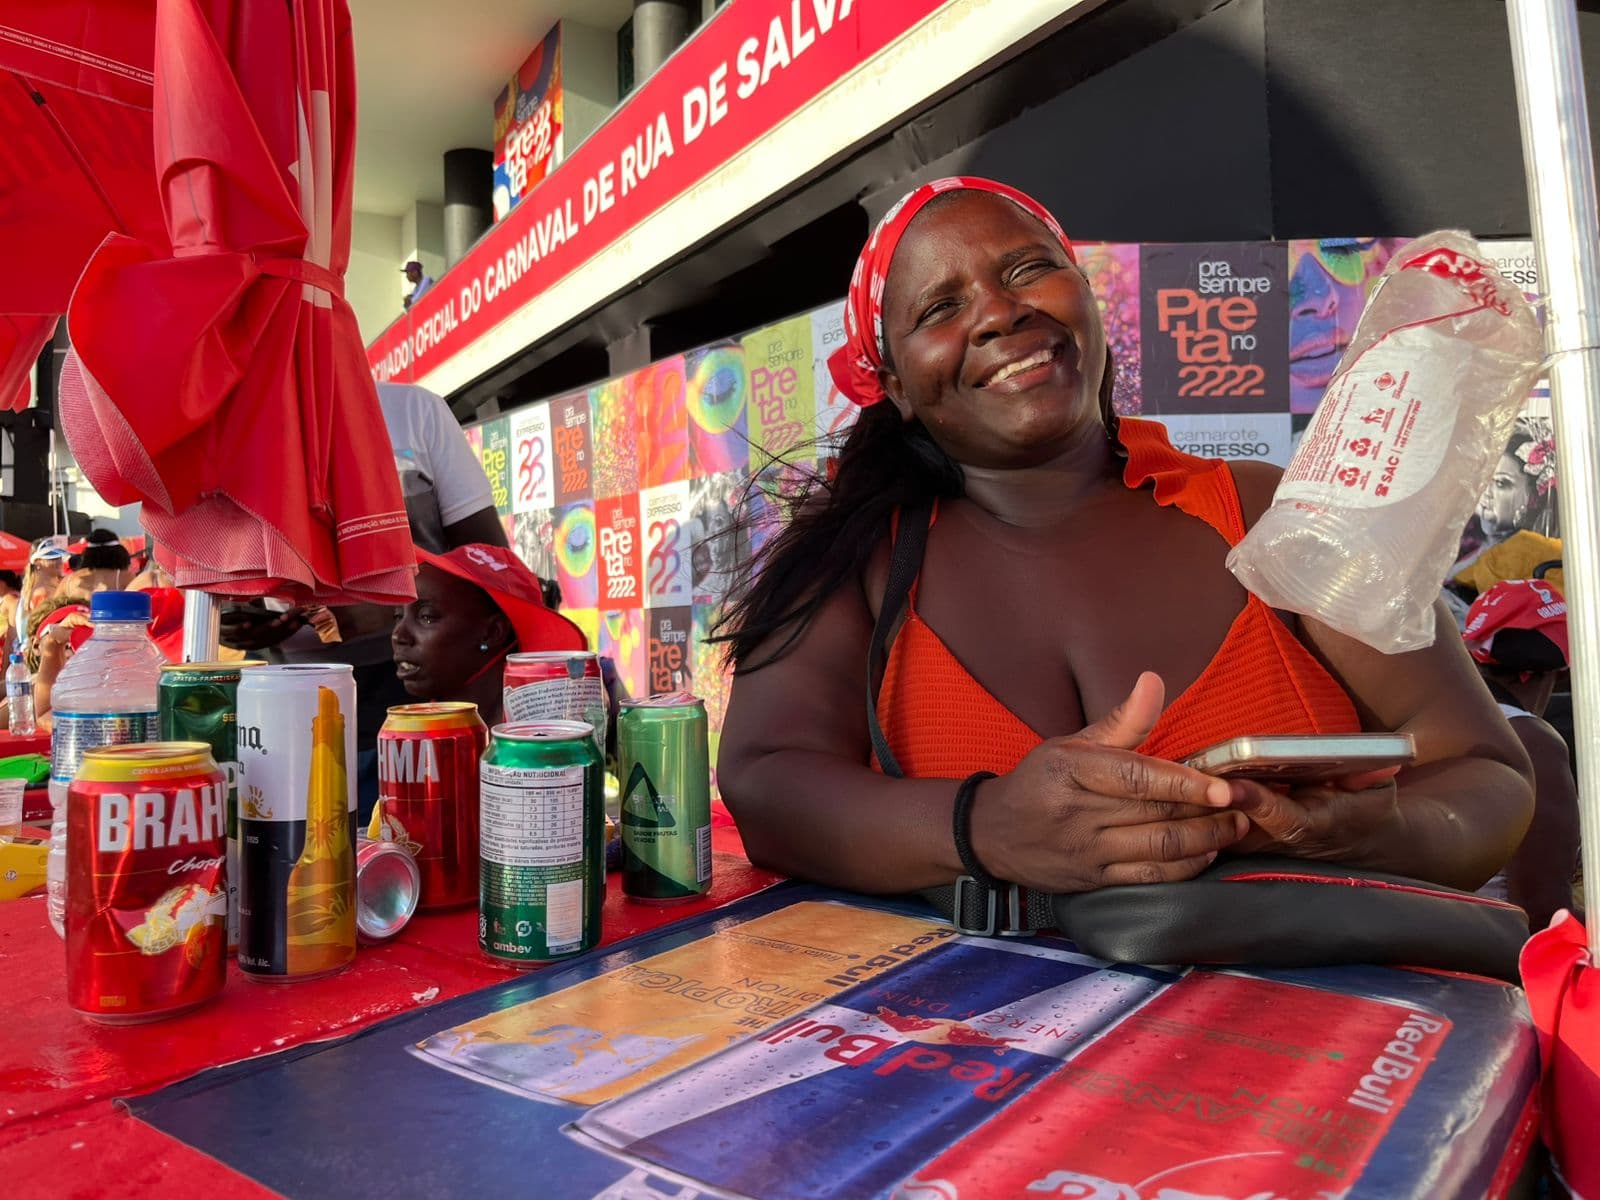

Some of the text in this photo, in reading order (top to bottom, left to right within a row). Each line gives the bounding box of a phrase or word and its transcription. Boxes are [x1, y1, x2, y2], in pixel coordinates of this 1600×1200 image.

[416, 298, 458, 357] OFICIAL
[461, 277, 481, 322] DO
[485, 198, 578, 303] CARNAVAL
[583, 161, 614, 226] DE
[621, 111, 674, 197] RUA
[683, 61, 728, 145] DE
[1199, 260, 1231, 281] pra
[1199, 276, 1271, 296] sempre
[1156, 288, 1258, 332] Pre
[1170, 320, 1257, 364] ta no
[750, 366, 798, 405] Pre
[1178, 363, 1265, 397] 2222
[758, 393, 786, 427] ta
[554, 426, 586, 458] Pre
[1174, 428, 1258, 442] camarote
[1174, 432, 1270, 457] XPRESSO
[1380, 454, 1401, 484] SAC
[600, 527, 633, 558] Pre
[605, 549, 626, 577] ta
[647, 637, 683, 671] Pre
[132, 765, 183, 776] CERVEJARIA
[493, 942, 532, 953] ambev
[757, 1017, 1032, 1102] Red Bull
[1346, 1012, 1443, 1115] Red Bull
